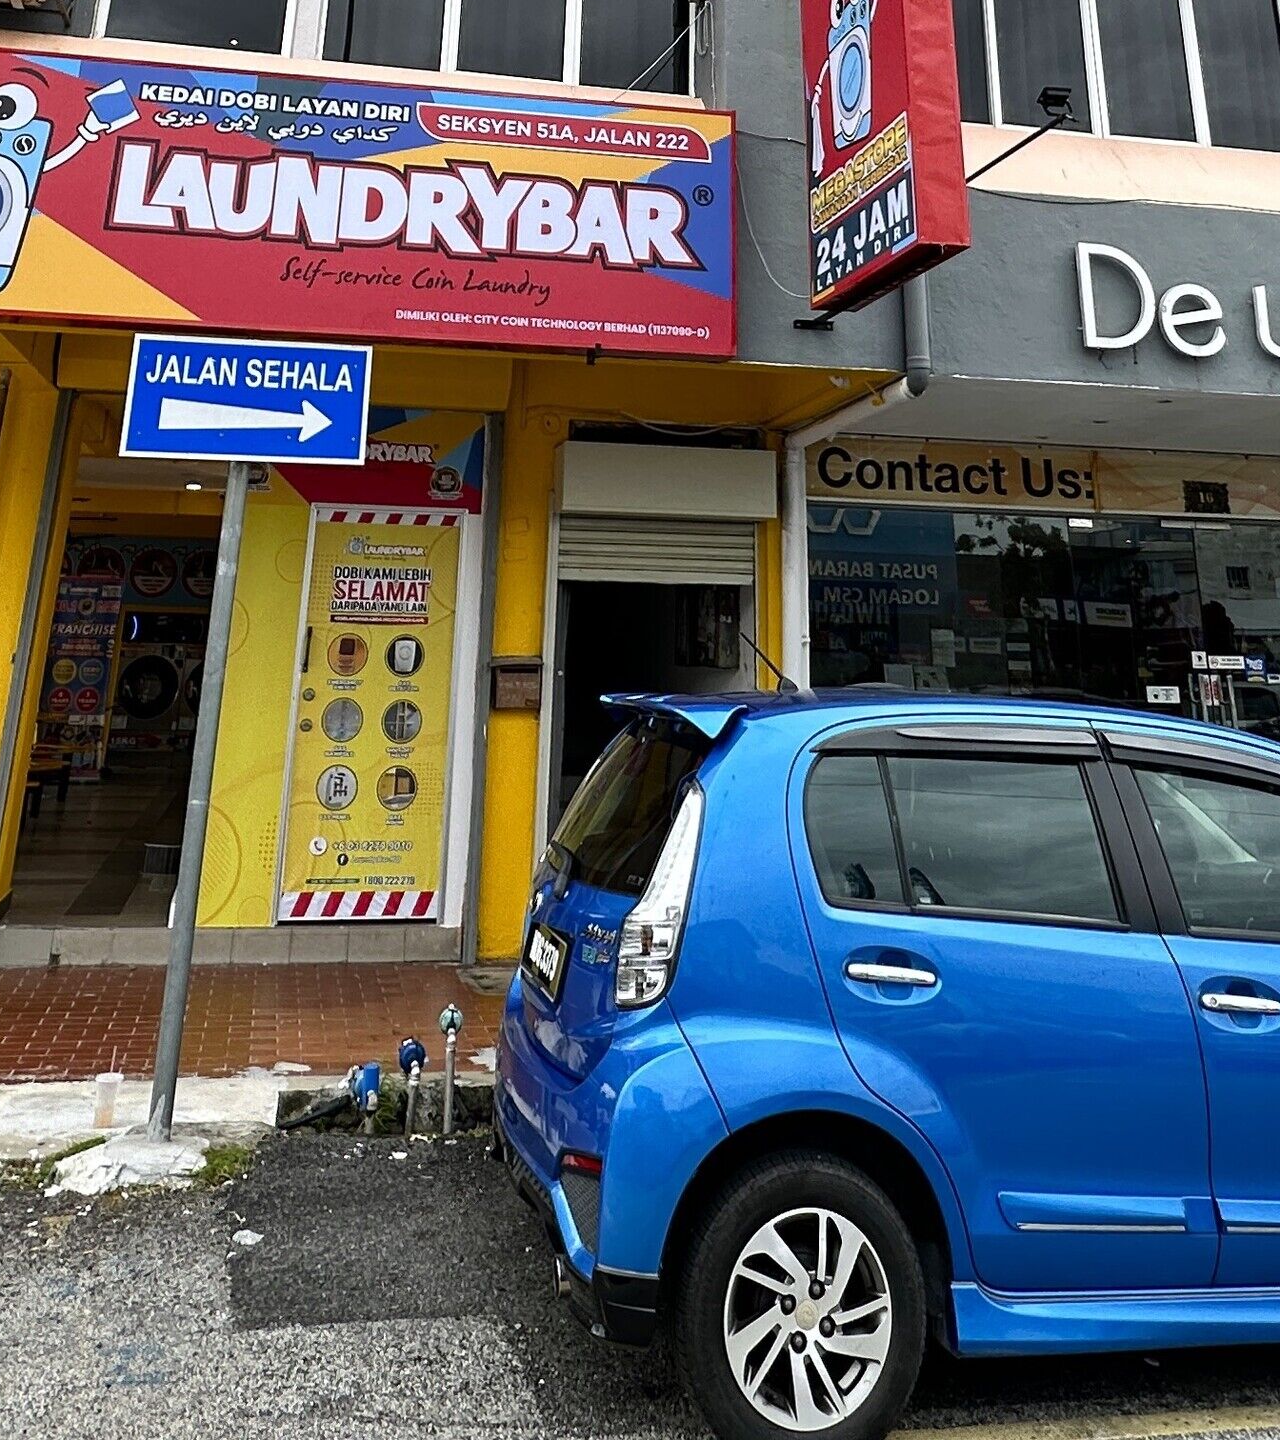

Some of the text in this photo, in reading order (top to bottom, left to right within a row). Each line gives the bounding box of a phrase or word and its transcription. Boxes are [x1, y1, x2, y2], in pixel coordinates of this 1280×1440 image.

[140, 84, 412, 123] KEDAI DOBI LAYAN DIRI
[268, 122, 324, 140] دوبي
[332, 125, 399, 144] كداي
[437, 113, 690, 150] SEKSYEN 51A, JALAN 222
[811, 117, 908, 209] MEGASTORE
[114, 140, 701, 269] LAUNDRYBAR
[816, 178, 909, 276] 24 JAM
[816, 219, 910, 292] LAYAN DIRI
[278, 255, 552, 307] Self-service Coin Laundry
[1076, 241, 1227, 357] De
[395, 309, 440, 321] DIMILIKI
[473, 313, 500, 326] CITY
[501, 315, 529, 327] COIN
[531, 317, 603, 332] TECHNOLOGY
[604, 322, 647, 335] BERHAD
[146, 352, 354, 394] JALAN SEHALA
[366, 442, 433, 463] RYBAR
[817, 446, 1093, 499] Contact Us:
[333, 579, 430, 602] SELAMAT
[334, 566, 432, 581] DOBI KAMI LEBIH
[331, 600, 378, 611] DARIPADA
